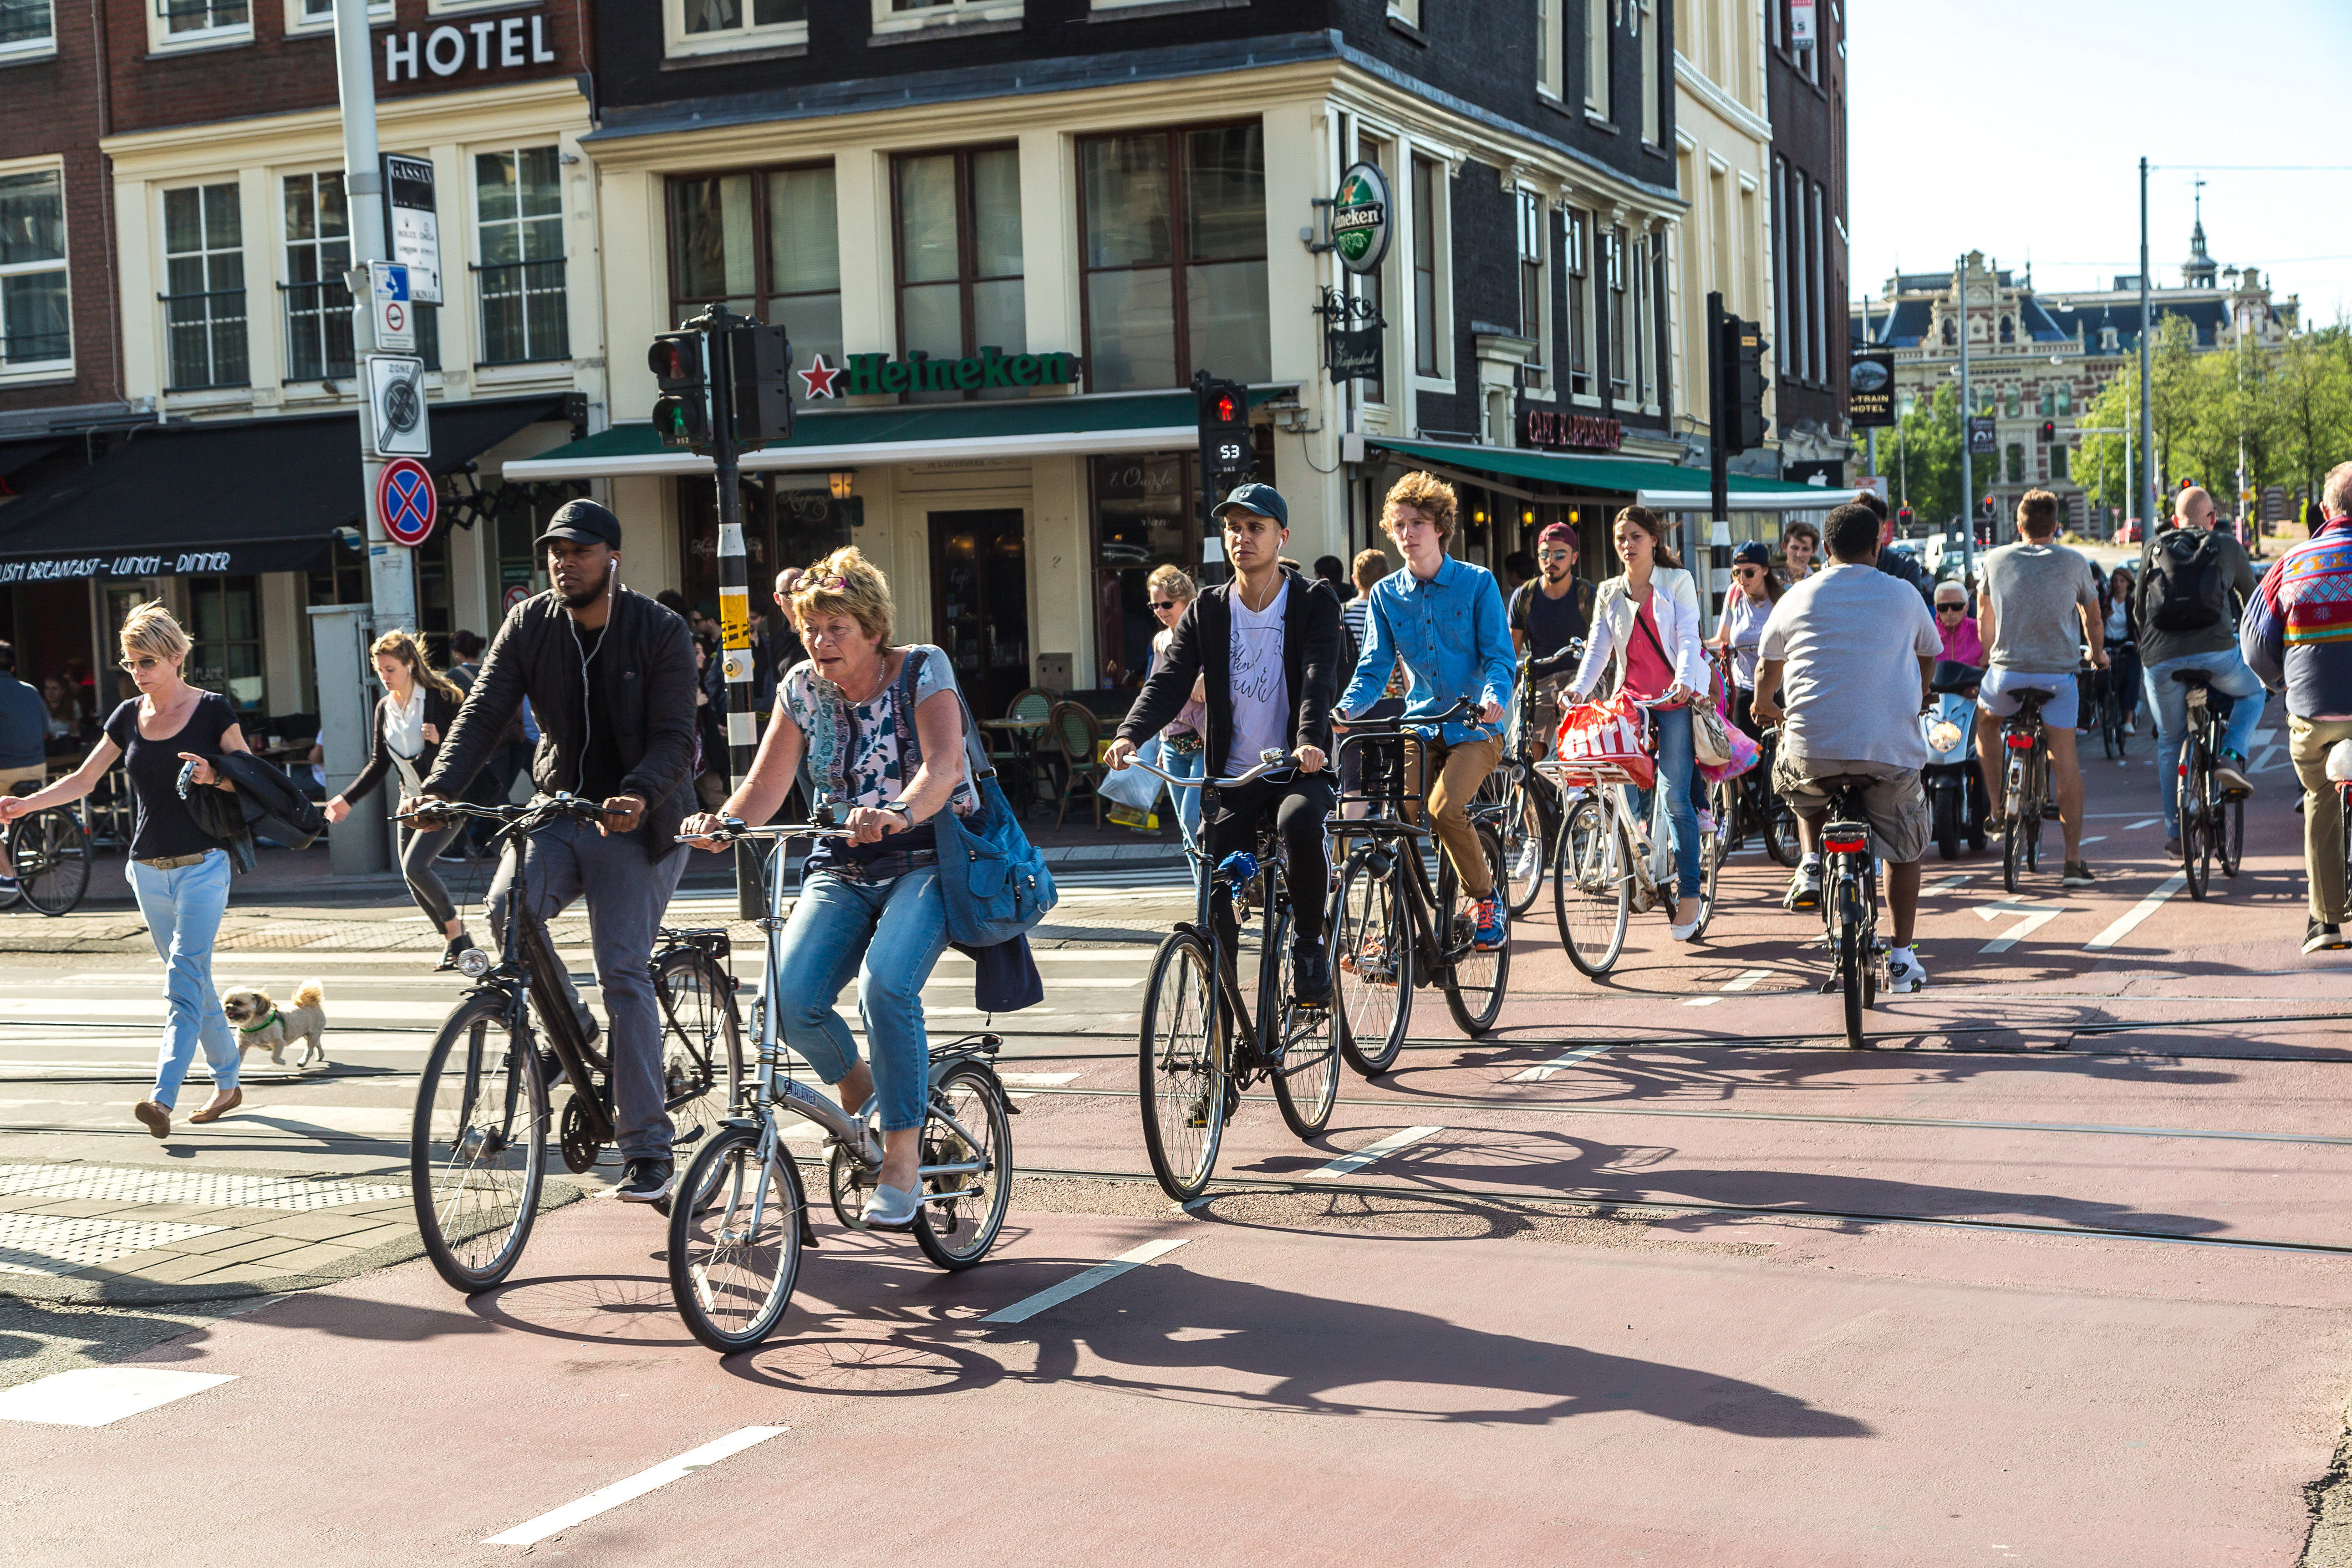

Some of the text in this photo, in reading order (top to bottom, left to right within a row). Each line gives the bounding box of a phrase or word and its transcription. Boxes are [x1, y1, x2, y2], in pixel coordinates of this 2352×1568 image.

[386, 15, 554, 82] HOTEL
[389, 363, 410, 374] ZONE
[846, 345, 1067, 395] Heineken
[1850, 404, 1886, 414] HOTEL
[1220, 445, 1240, 459] 53
[27, 558, 101, 581] BREAKFAST
[110, 555, 161, 575] LUNCH
[175, 552, 231, 573] DINNER
